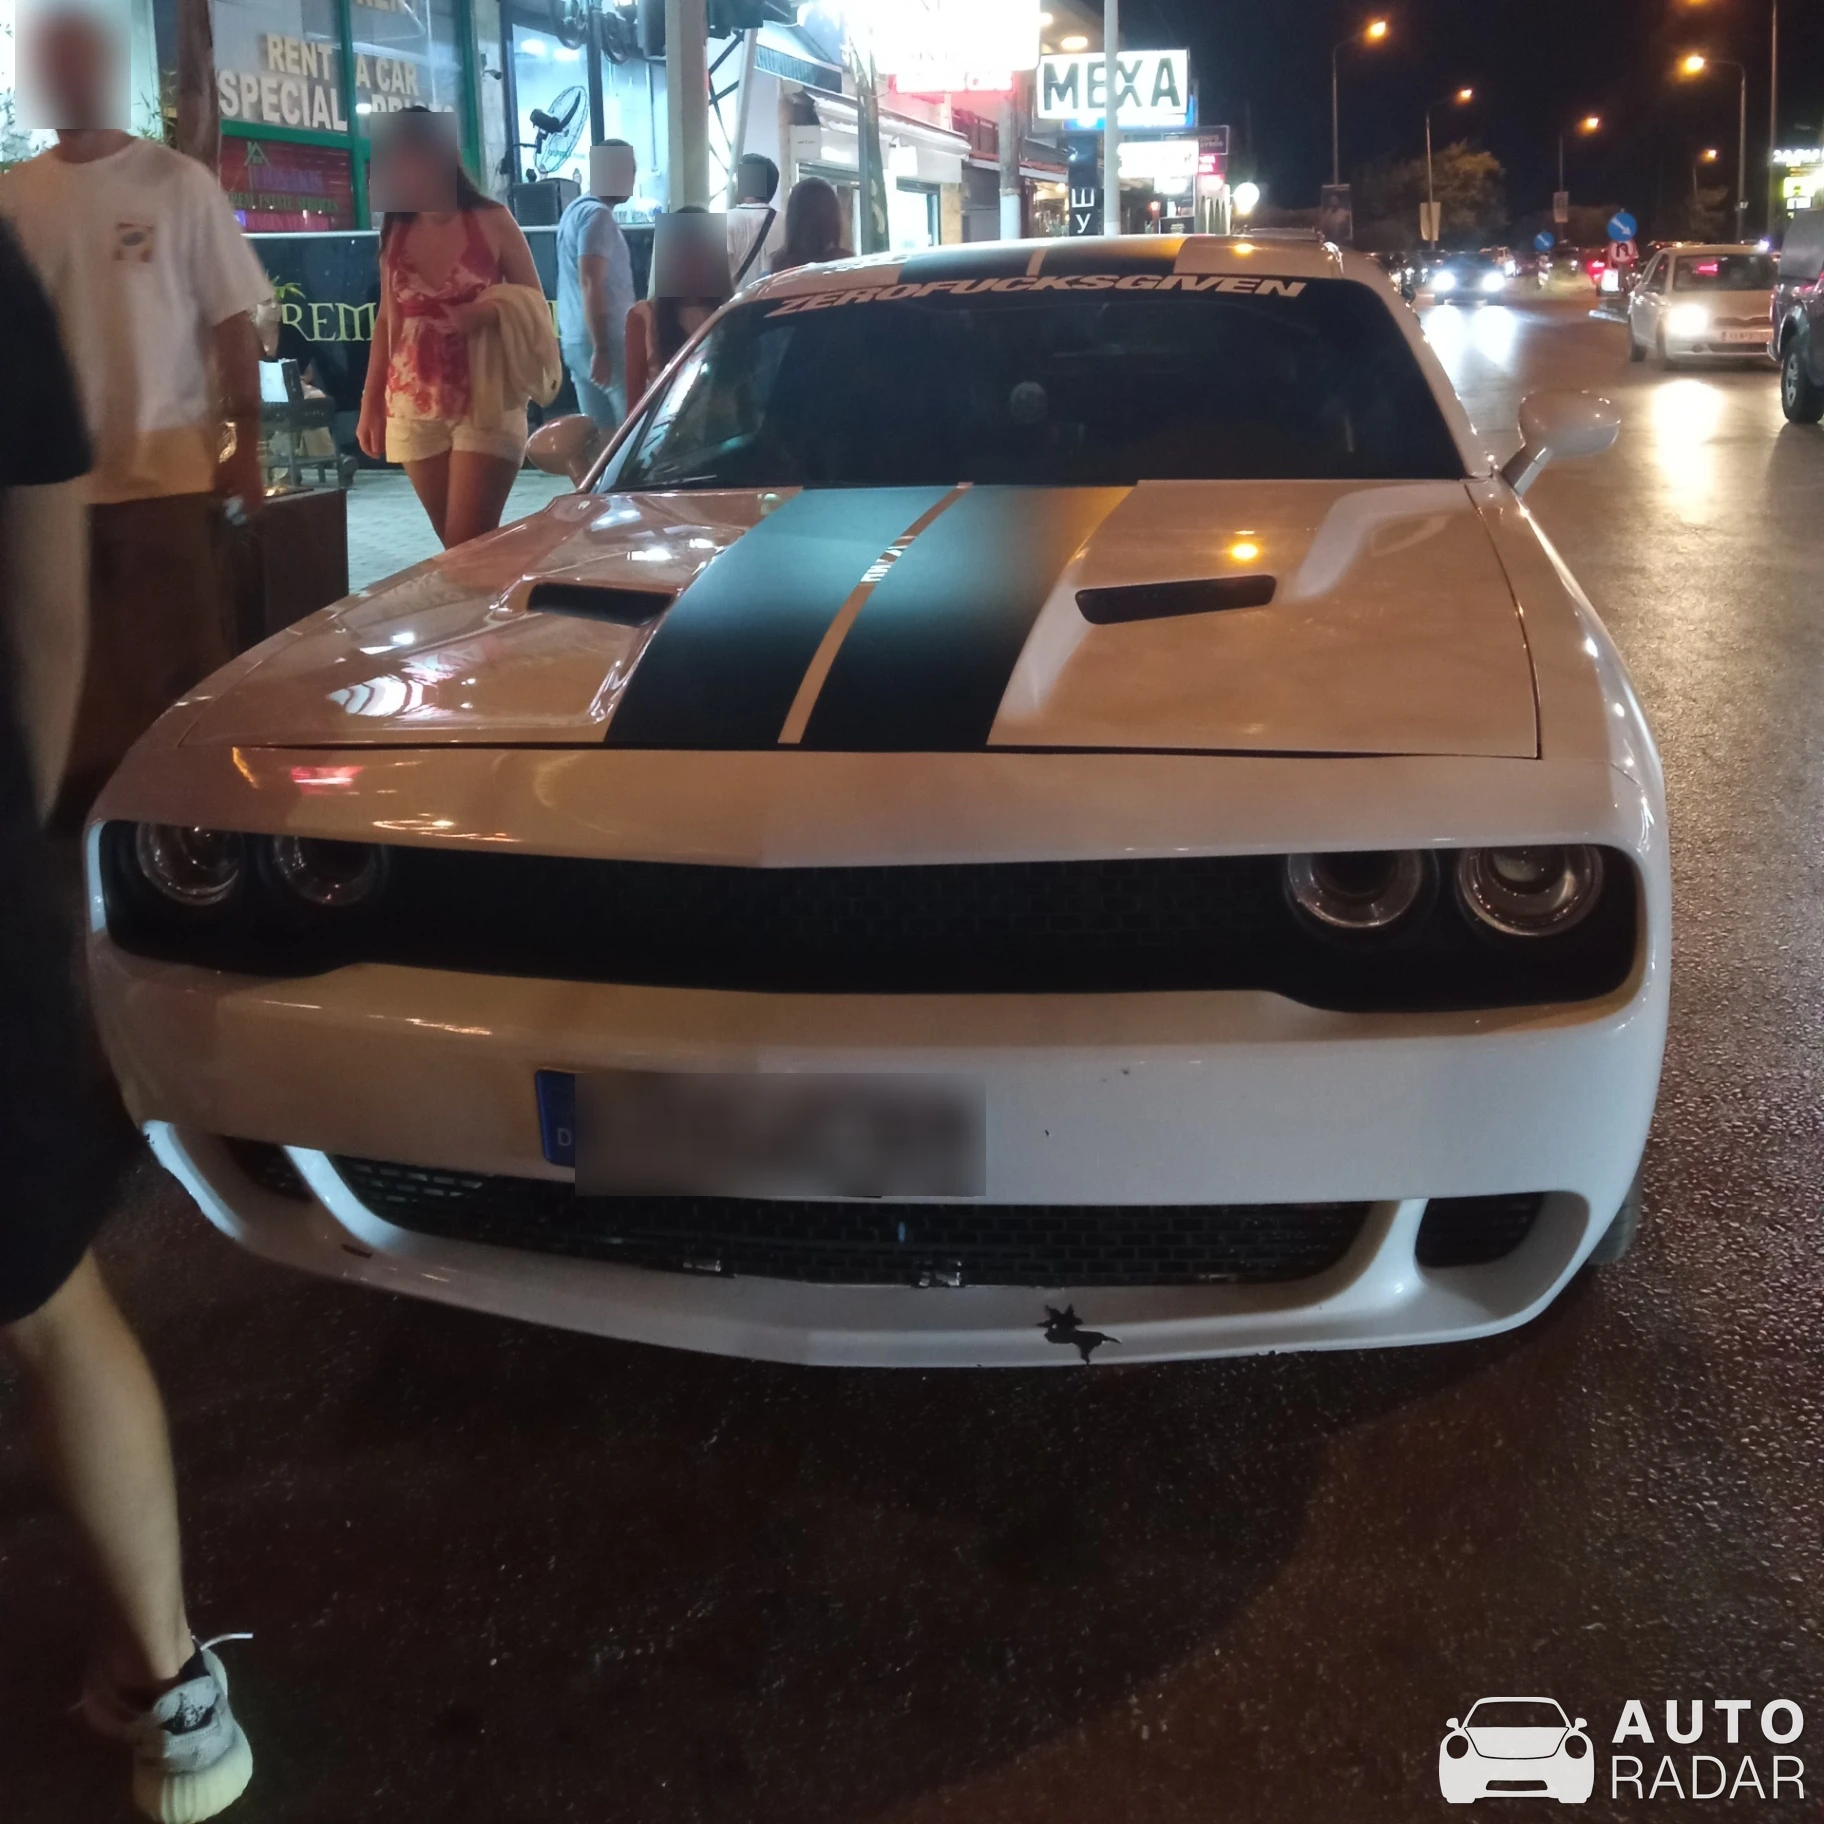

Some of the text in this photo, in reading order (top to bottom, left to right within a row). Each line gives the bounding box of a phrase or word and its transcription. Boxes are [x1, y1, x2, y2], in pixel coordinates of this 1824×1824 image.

[266, 33, 419, 96] RENT A CAR
[218, 69, 348, 131] SPECIAL
[764, 274, 1307, 318] ZEROFUCKSGIVEN
[280, 302, 376, 341] REM
[557, 1127, 573, 1146] D
